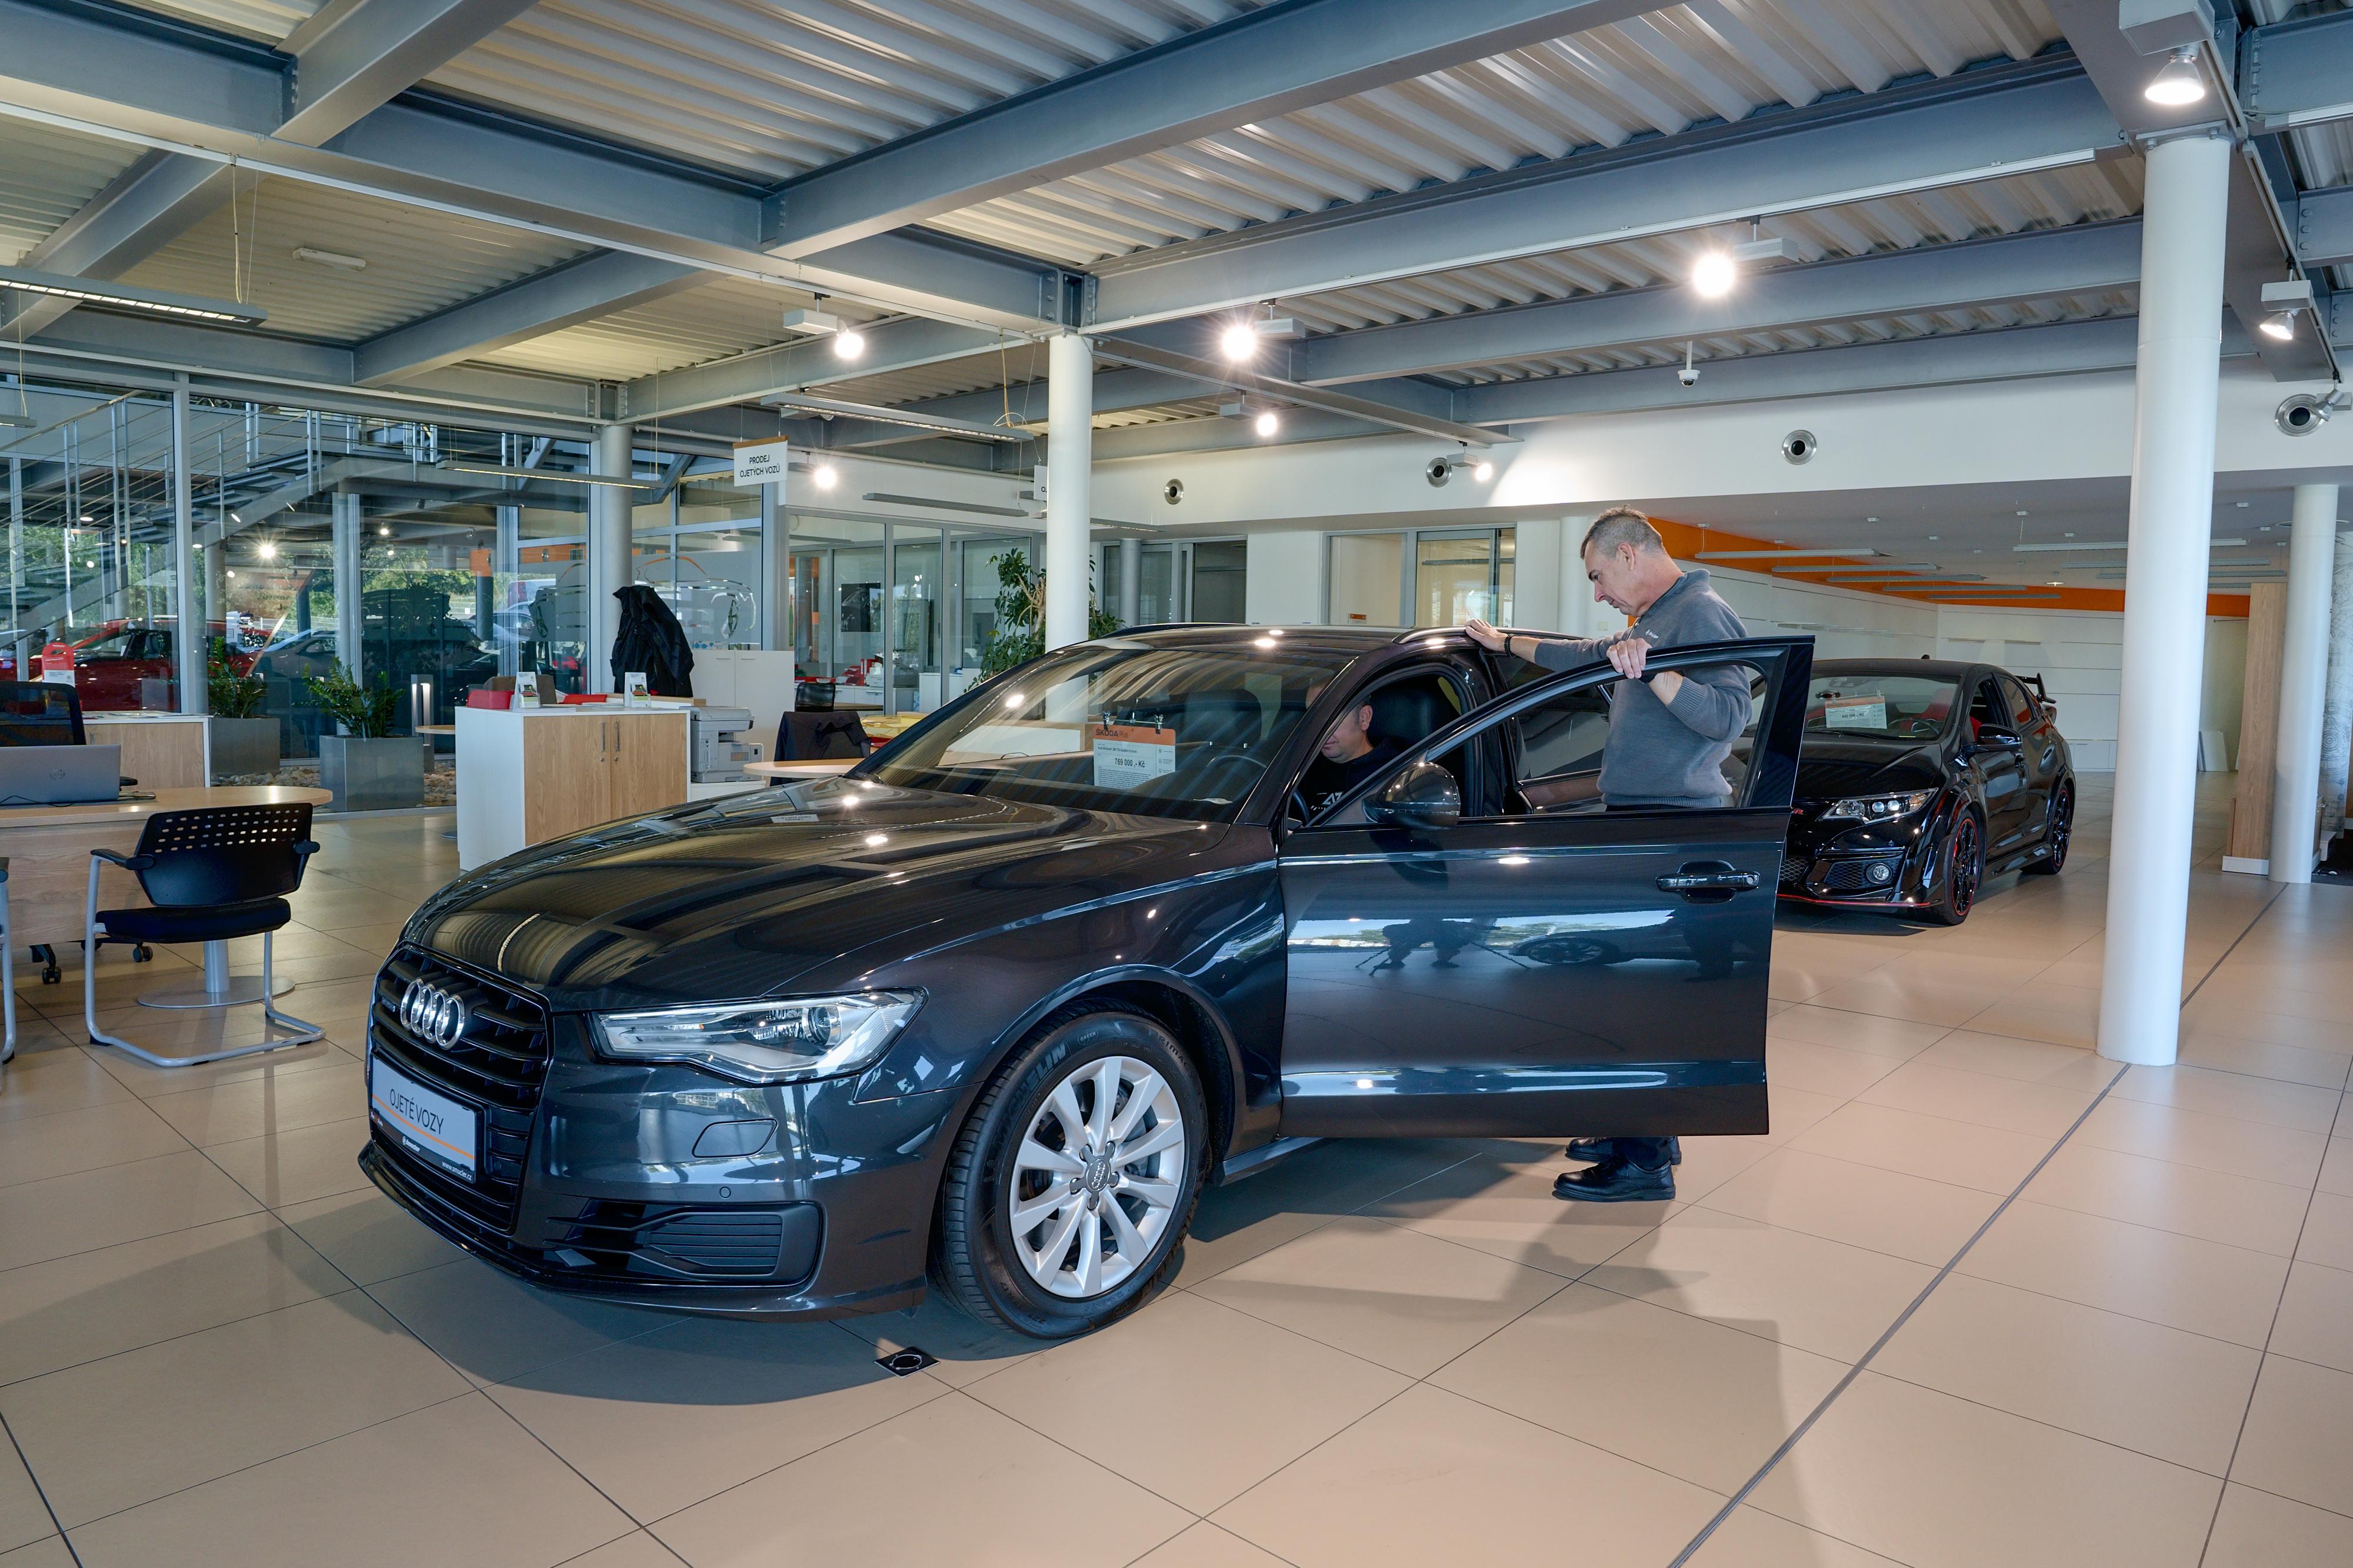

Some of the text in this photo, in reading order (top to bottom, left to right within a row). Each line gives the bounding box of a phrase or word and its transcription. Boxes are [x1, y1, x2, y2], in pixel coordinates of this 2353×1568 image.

[749, 455, 770, 465] PRODEJ
[739, 463, 780, 478] OJETÝCH VOZŮ
[1096, 728, 1119, 737] ŠKODA
[1115, 758, 1123, 766] 769
[1124, 759, 1133, 767] 000
[1138, 760, 1146, 768] Kč
[389, 1088, 444, 1135] OJETÉ VOZY
